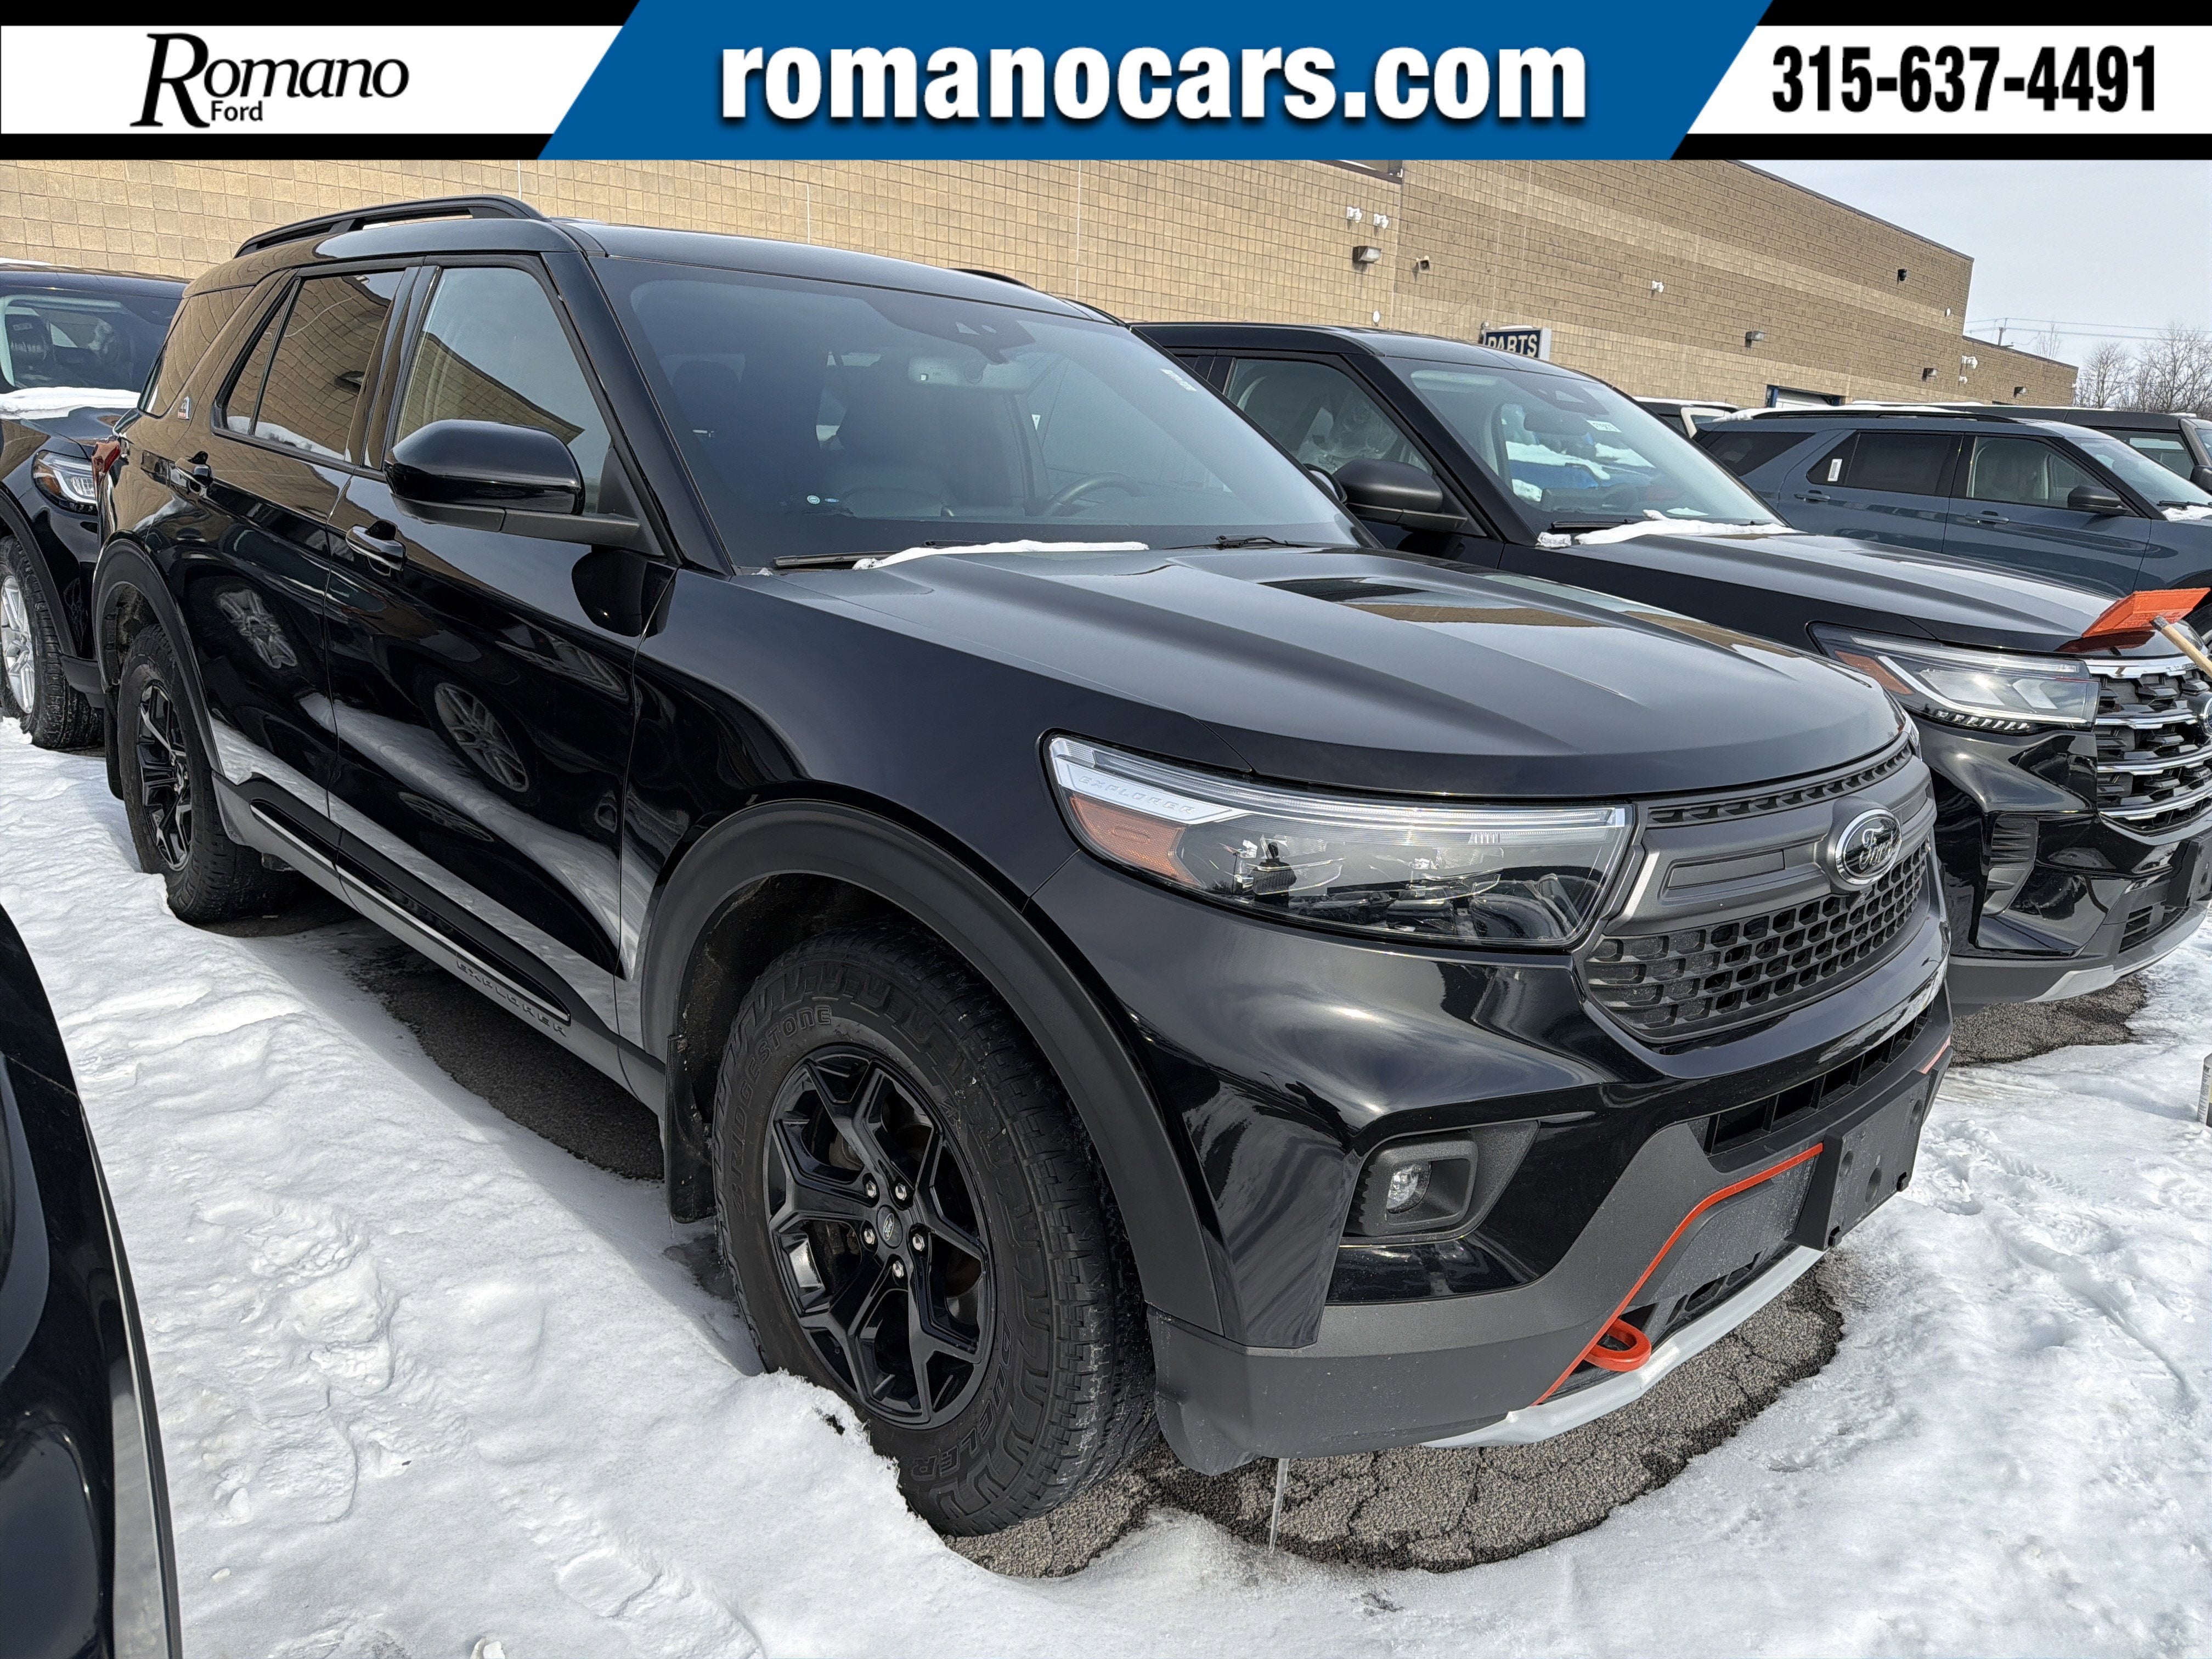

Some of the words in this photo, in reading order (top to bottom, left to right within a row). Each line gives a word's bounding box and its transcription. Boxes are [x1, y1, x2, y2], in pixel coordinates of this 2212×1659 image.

[1079, 776, 1197, 814] EXPLORER
[1859, 824, 1897, 870] Ford
[456, 961, 567, 1037] EXPLORER
[731, 1004, 833, 1220] BRIDGESTONE
[911, 1312, 1014, 1481] DUELER
